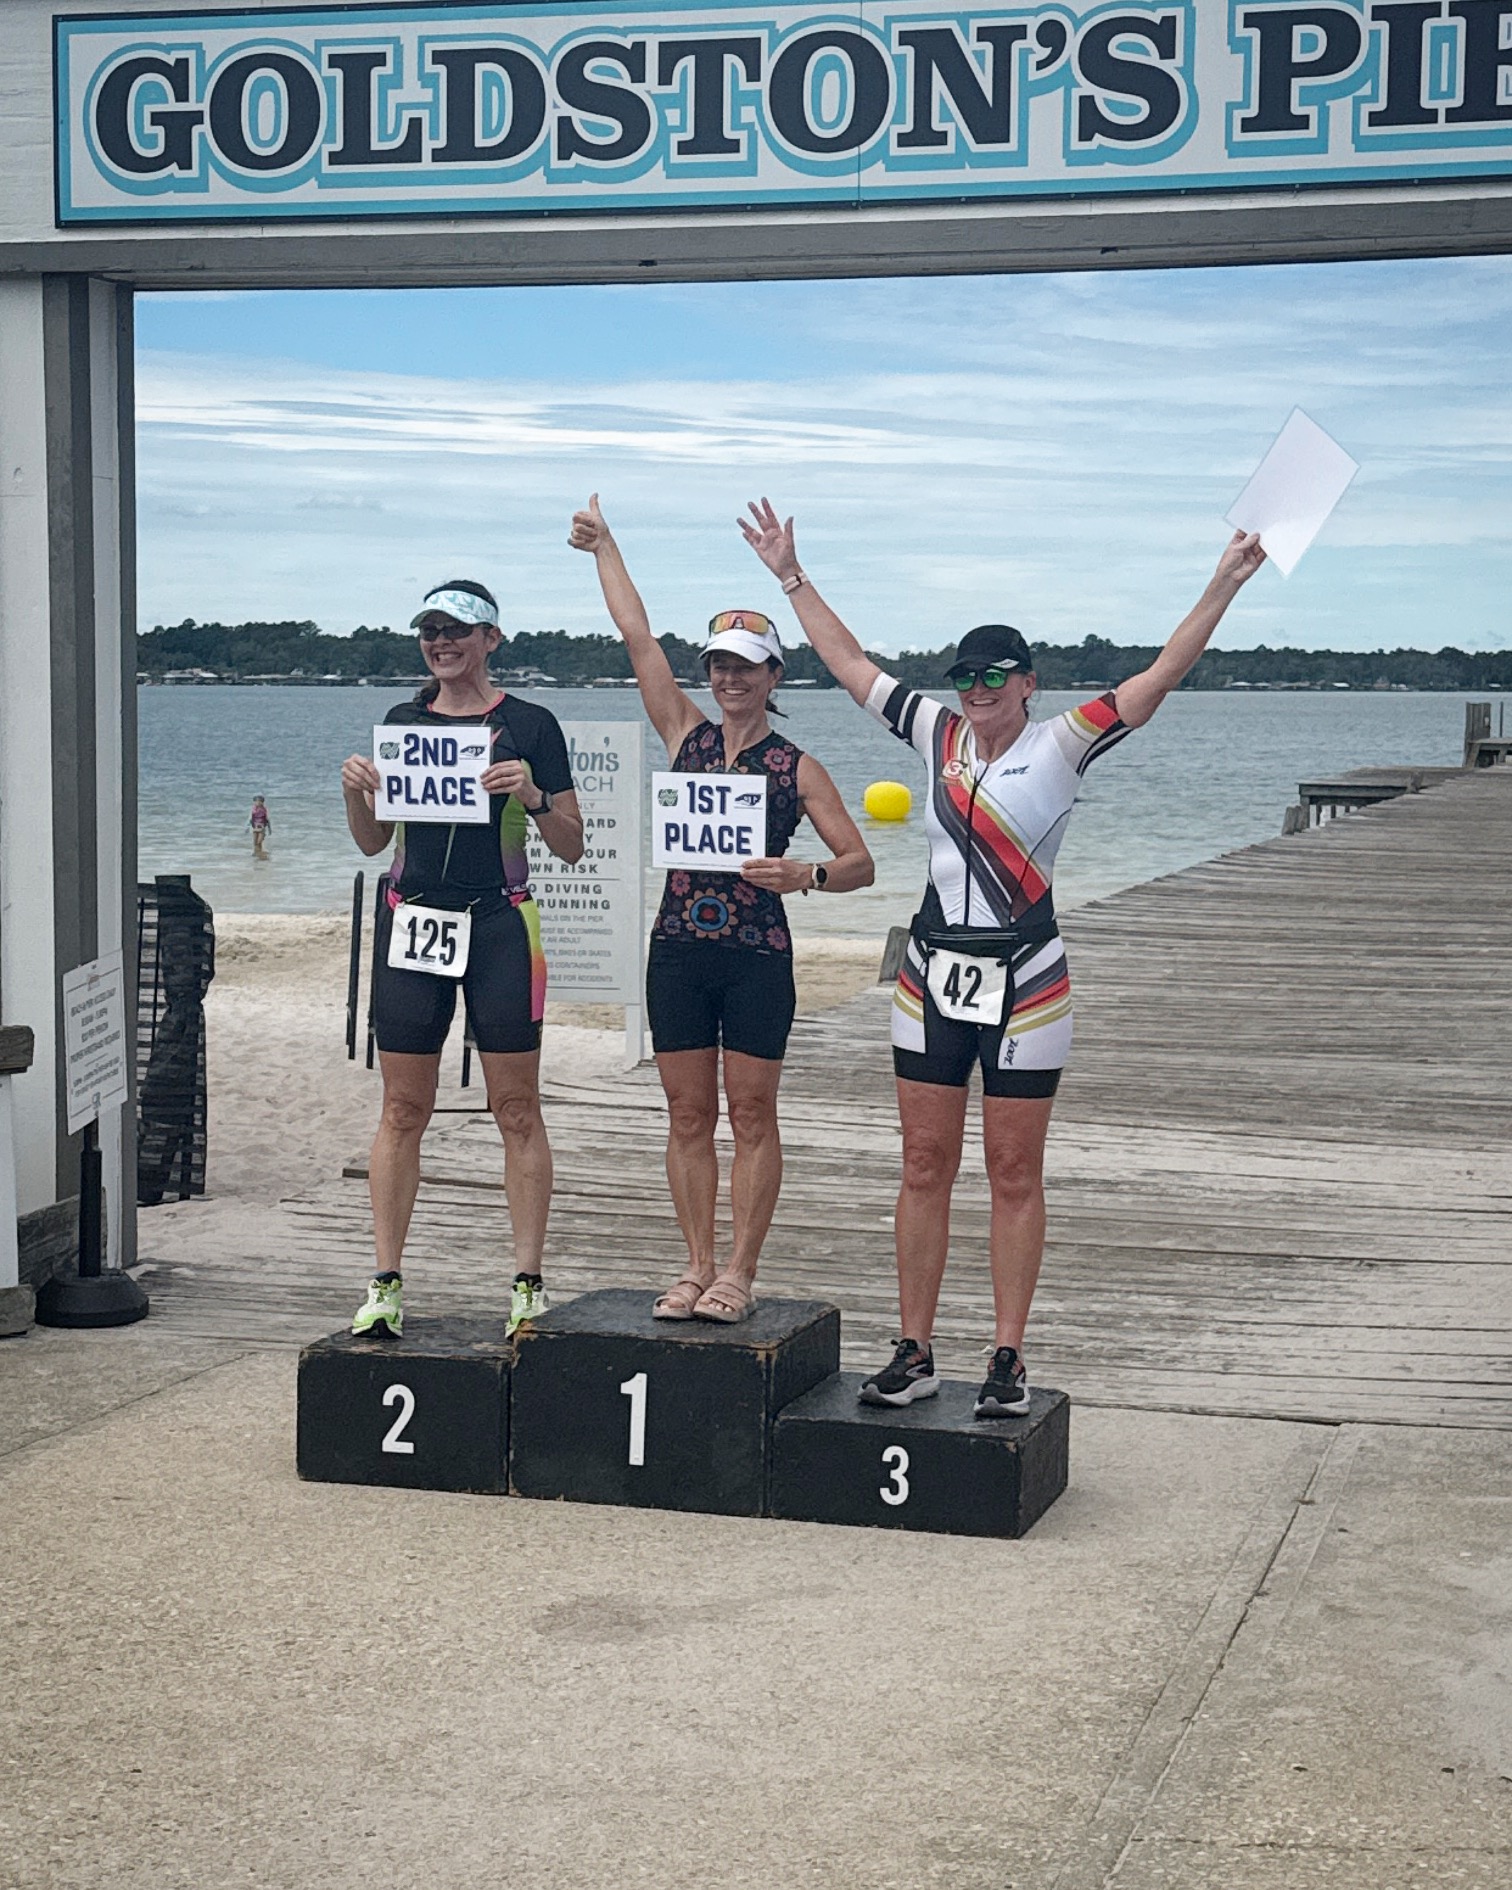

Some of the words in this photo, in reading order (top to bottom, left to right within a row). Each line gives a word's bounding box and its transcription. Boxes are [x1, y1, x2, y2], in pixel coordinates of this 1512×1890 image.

[95, 14, 1182, 174] GOLDSTON'S
[403, 733, 458, 767] 2ND
[386, 775, 477, 806] PLACE
[572, 775, 614, 793] ACH
[686, 780, 732, 815] 1ST
[584, 848, 617, 860] OUR
[664, 822, 753, 856] PLACE
[529, 863, 553, 874] WN
[560, 863, 599, 874] RISK
[536, 898, 611, 910] RUNNING
[544, 883, 603, 895] DIVING
[404, 915, 458, 967] 125
[943, 962, 982, 1009] 42
[381, 1384, 415, 1454] 2
[620, 1373, 648, 1467] 1
[879, 1445, 909, 1506] 3
